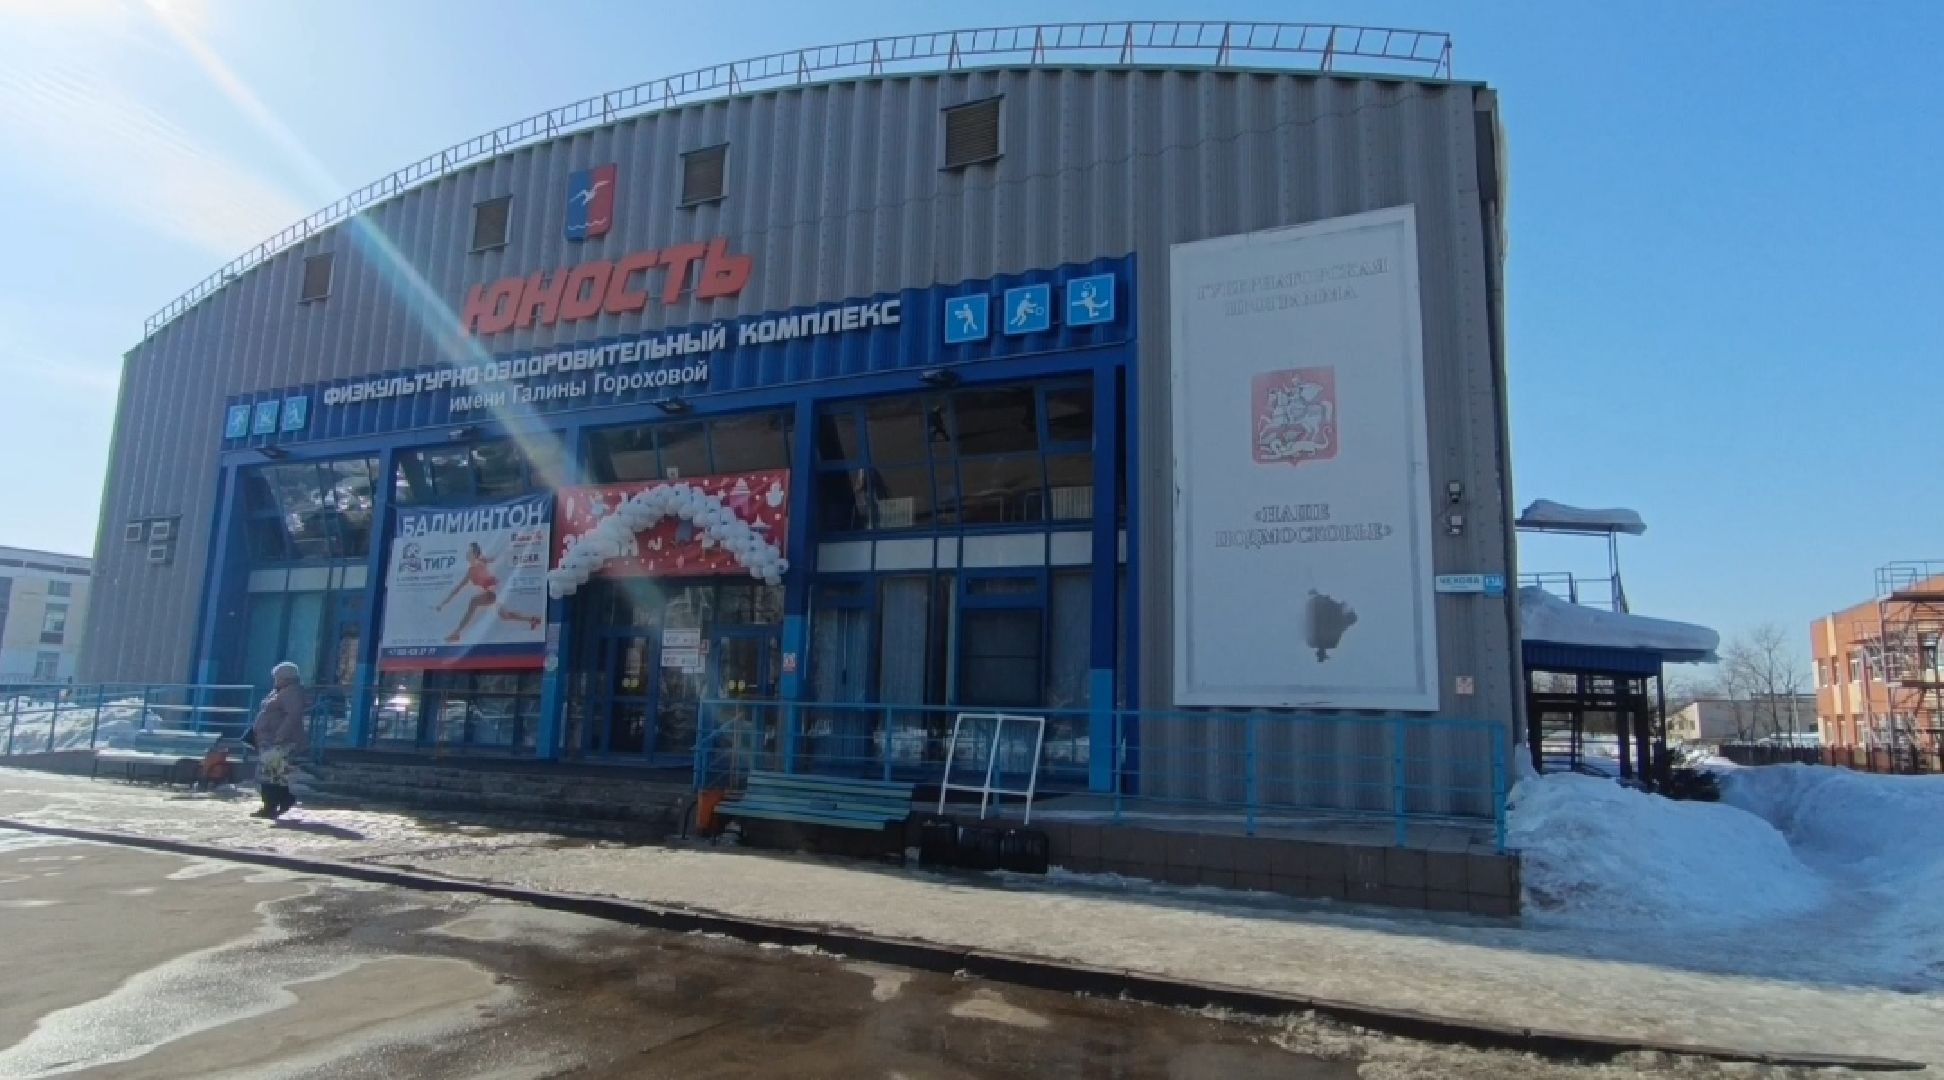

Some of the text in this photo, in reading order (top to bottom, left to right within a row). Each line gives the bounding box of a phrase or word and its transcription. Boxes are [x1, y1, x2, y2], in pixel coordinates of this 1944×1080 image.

[463, 236, 752, 335] ЮНОСТЬ
[738, 299, 901, 346] КОМПЛЕКС
[450, 360, 708, 413] имени Галины Гороховой
[402, 502, 543, 537] БАДМИНТОН
[423, 555, 457, 572] ТИГР
